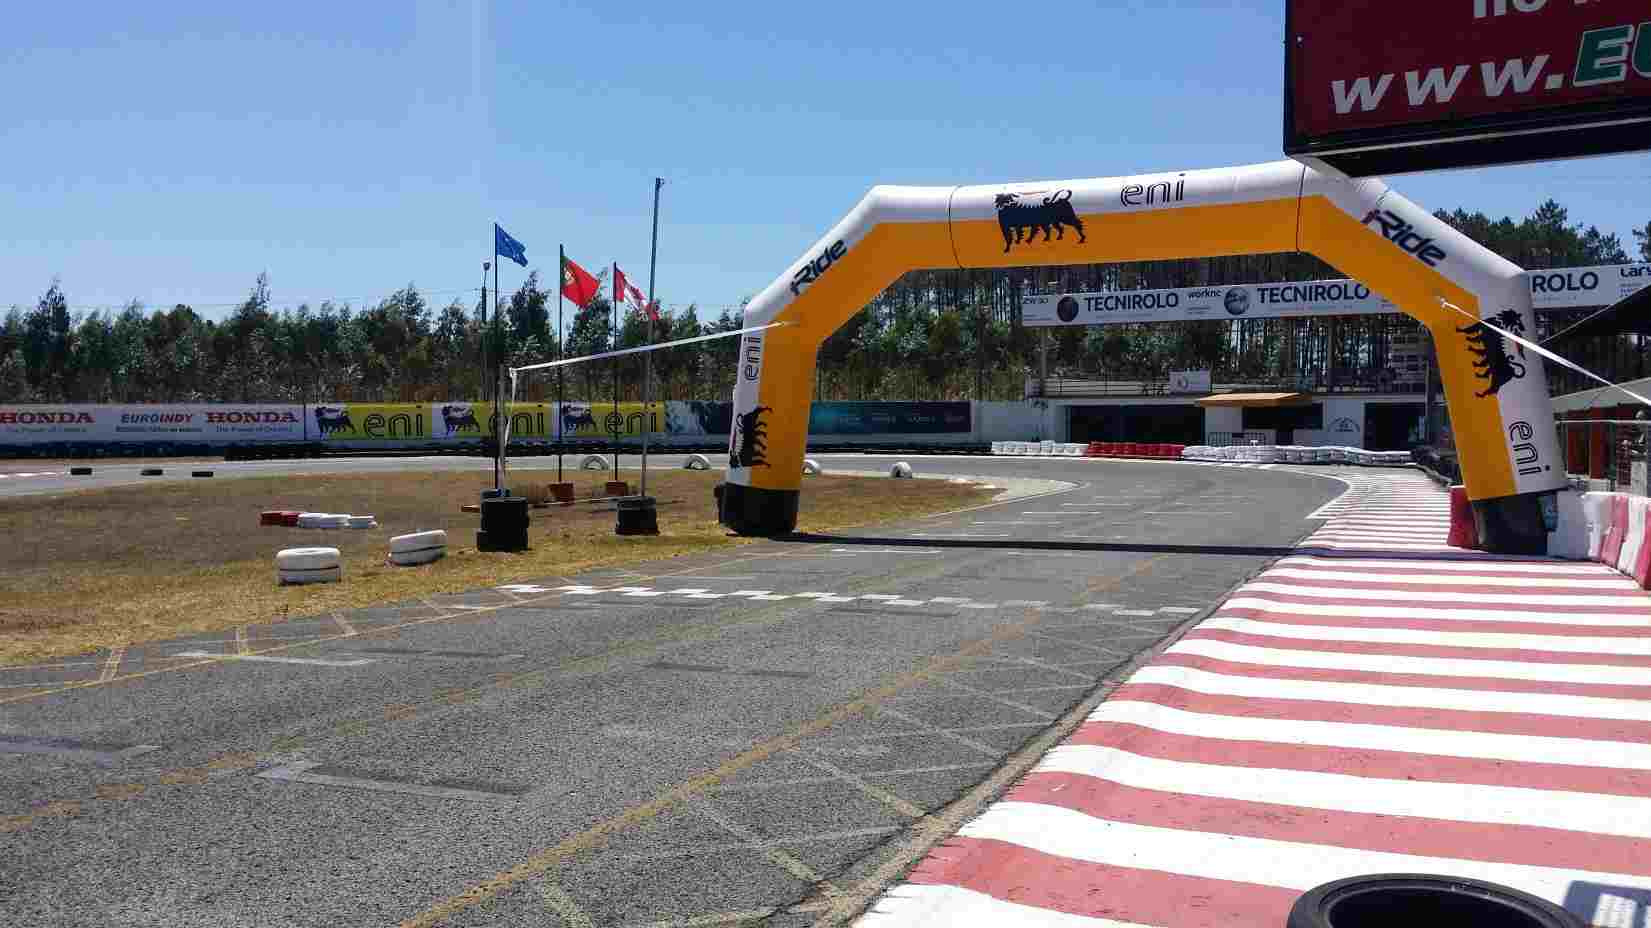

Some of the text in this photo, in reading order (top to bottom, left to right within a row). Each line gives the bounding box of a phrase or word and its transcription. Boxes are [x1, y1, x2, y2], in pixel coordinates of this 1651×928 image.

[1120, 172, 1186, 207] eni
[1084, 292, 1179, 312] TECNIROLO
[1258, 283, 1370, 304] TECNIROLO
[744, 336, 761, 381] eni
[0, 412, 94, 424] HONDA
[206, 411, 299, 424] HONDA
[363, 404, 424, 438] eni
[488, 404, 545, 438] eni
[604, 404, 658, 437] eni
[1508, 420, 1551, 475] eni
